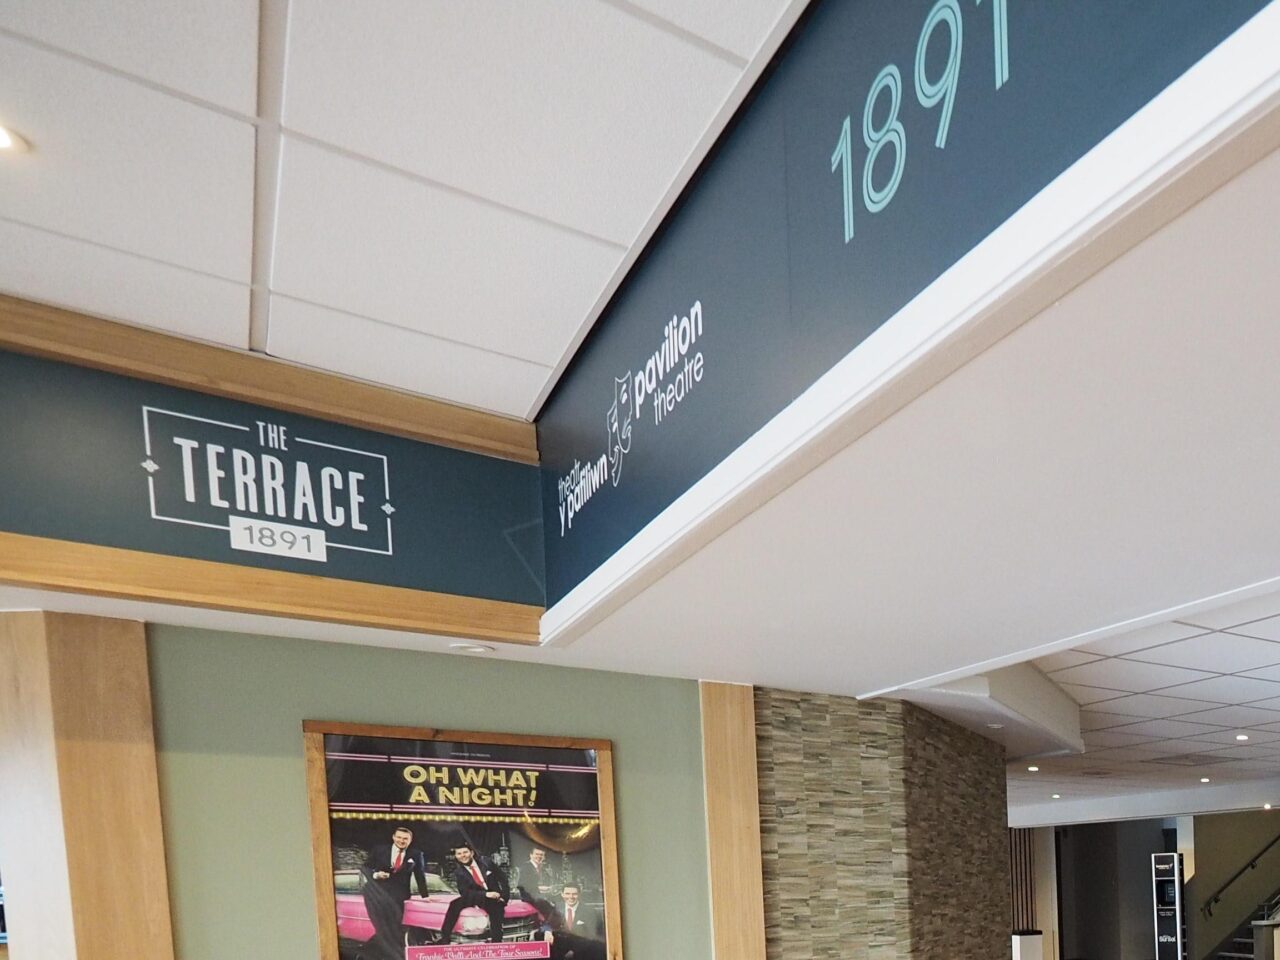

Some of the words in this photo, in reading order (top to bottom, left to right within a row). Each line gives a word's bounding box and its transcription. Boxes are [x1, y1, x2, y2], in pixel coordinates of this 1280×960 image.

[831, 0, 1010, 245] 1891
[634, 300, 704, 419] pavilion
[654, 351, 704, 426] theatre
[256, 421, 288, 452] THE
[173, 437, 368, 531] TERRACE
[558, 458, 586, 498] theatr
[559, 501, 568, 537] y
[567, 453, 609, 528] pafiliwn
[242, 525, 315, 554] 1891
[403, 765, 449, 785] OH
[456, 767, 539, 789] WHAT
[409, 786, 430, 804] A
[439, 787, 538, 807] NIGHT!
